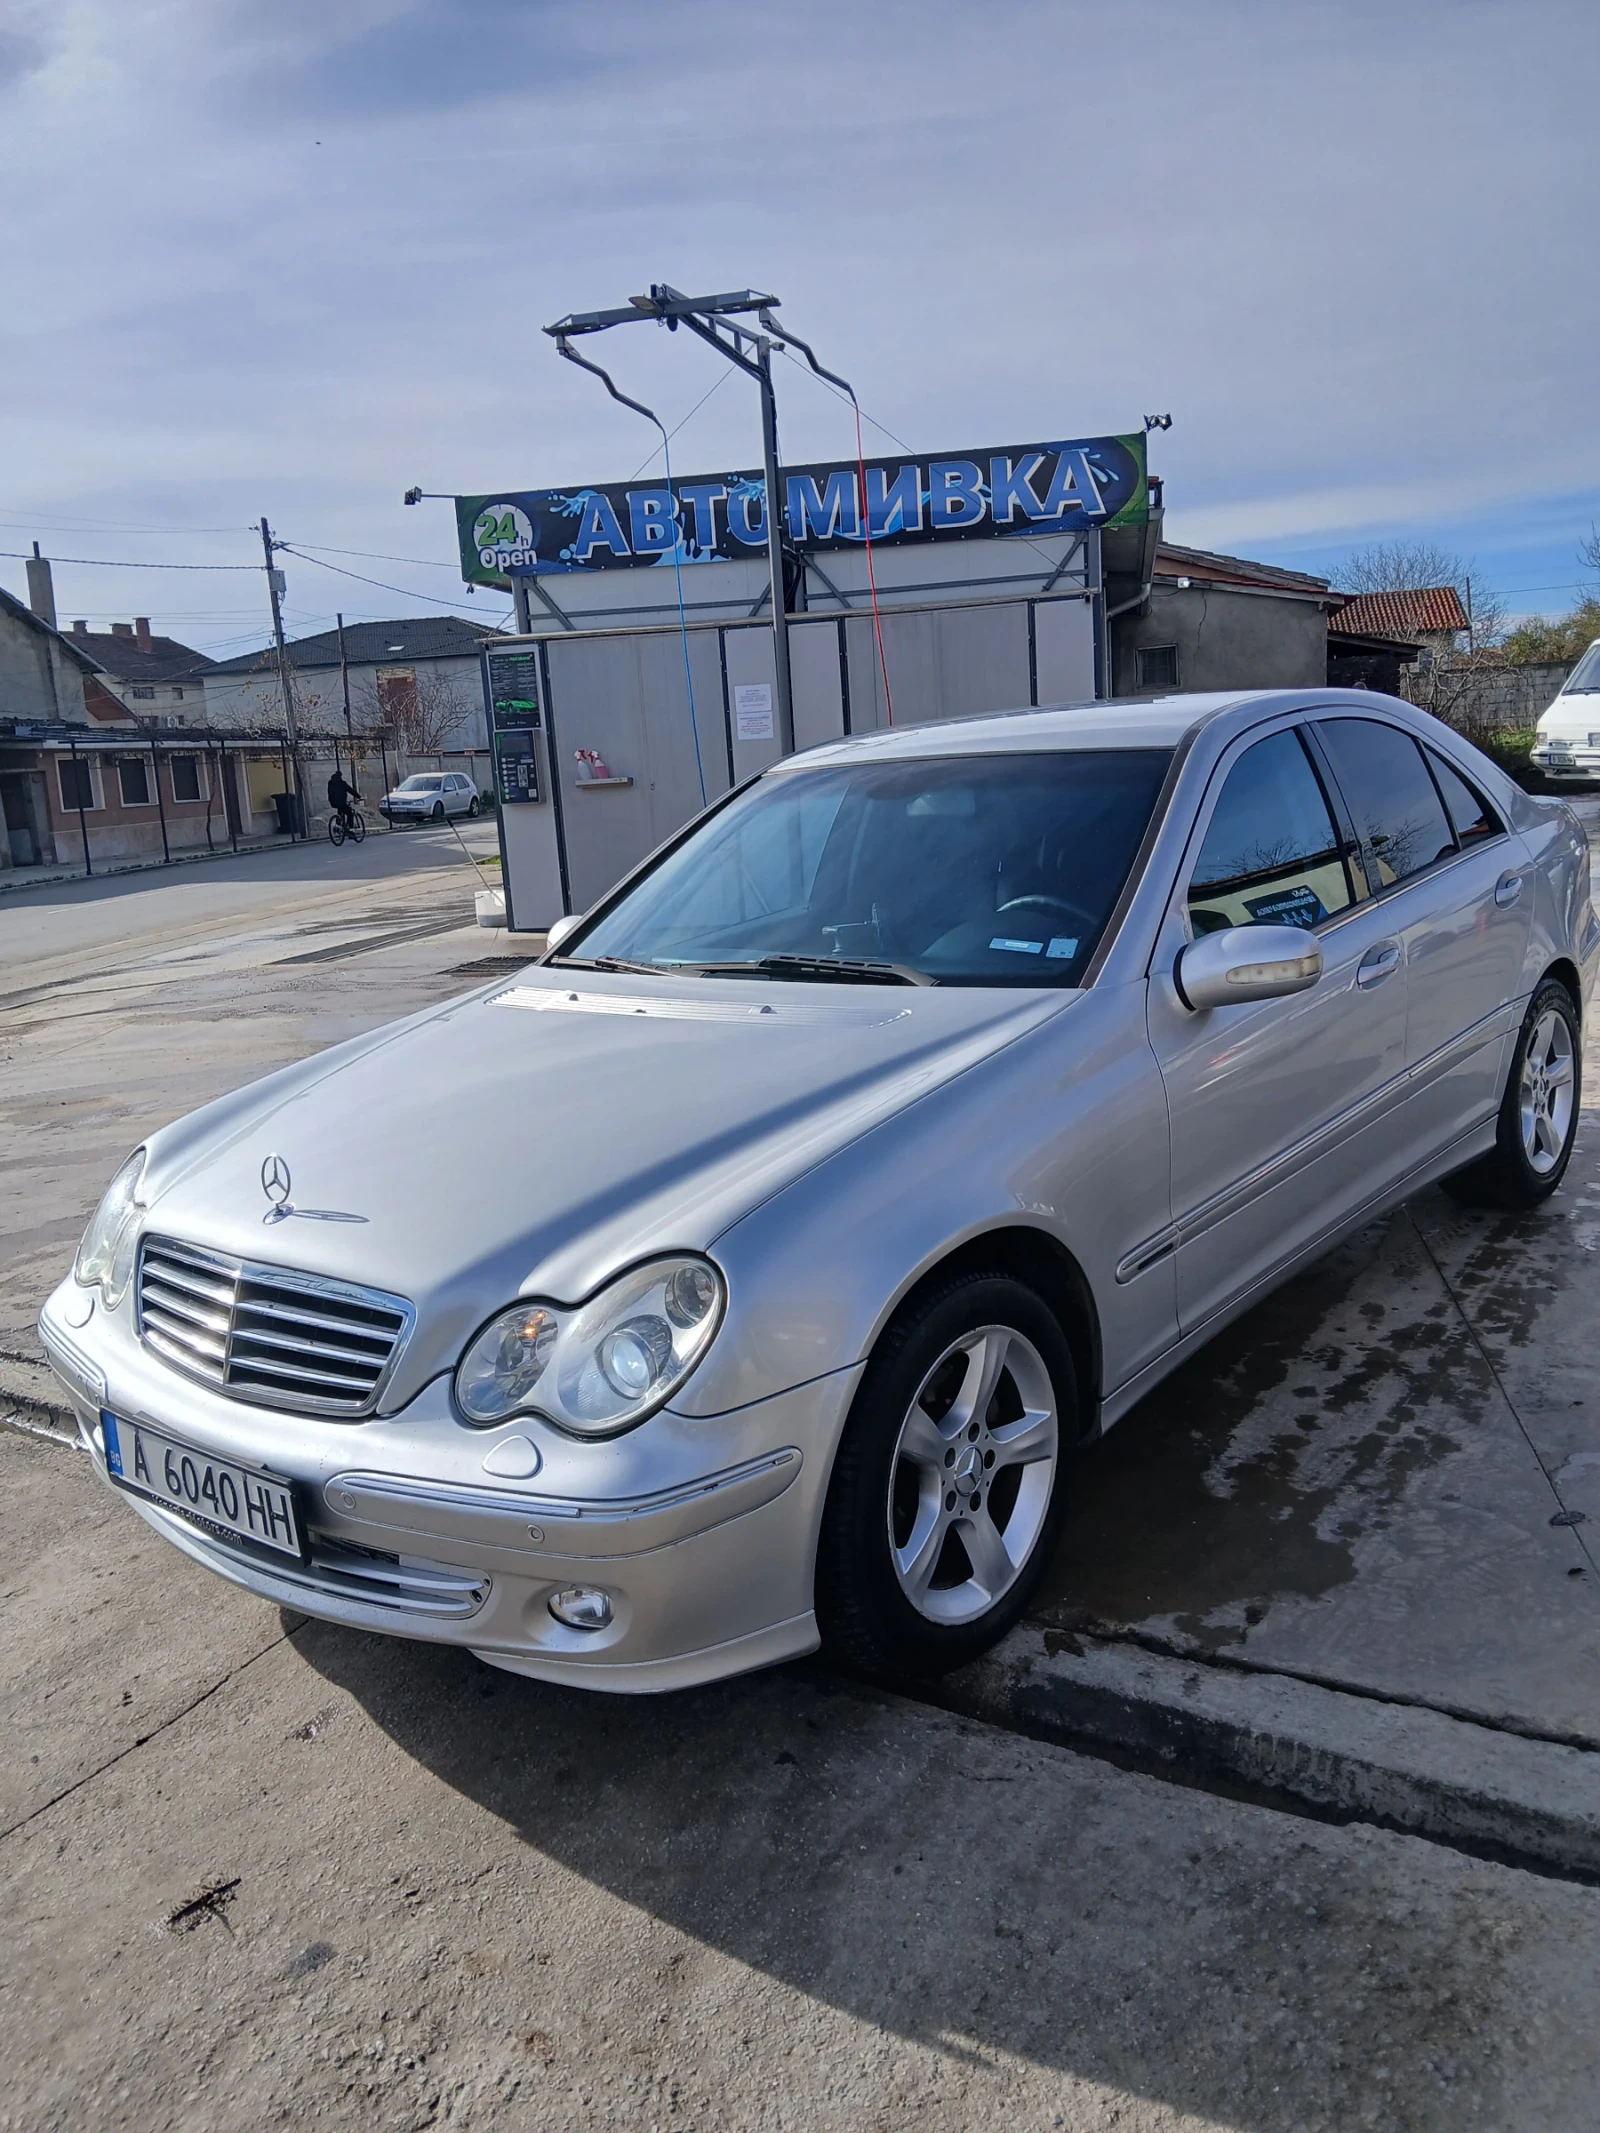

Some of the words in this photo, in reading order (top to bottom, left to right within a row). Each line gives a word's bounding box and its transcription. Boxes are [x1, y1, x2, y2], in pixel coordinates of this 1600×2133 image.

[575, 449, 1107, 559] АВТОМИВКА
[481, 548, 537, 572] Open
[110, 1450, 121, 1466] BG
[134, 1429, 152, 1485] A
[164, 1447, 239, 1522] 6040
[243, 1473, 294, 1546] HH
